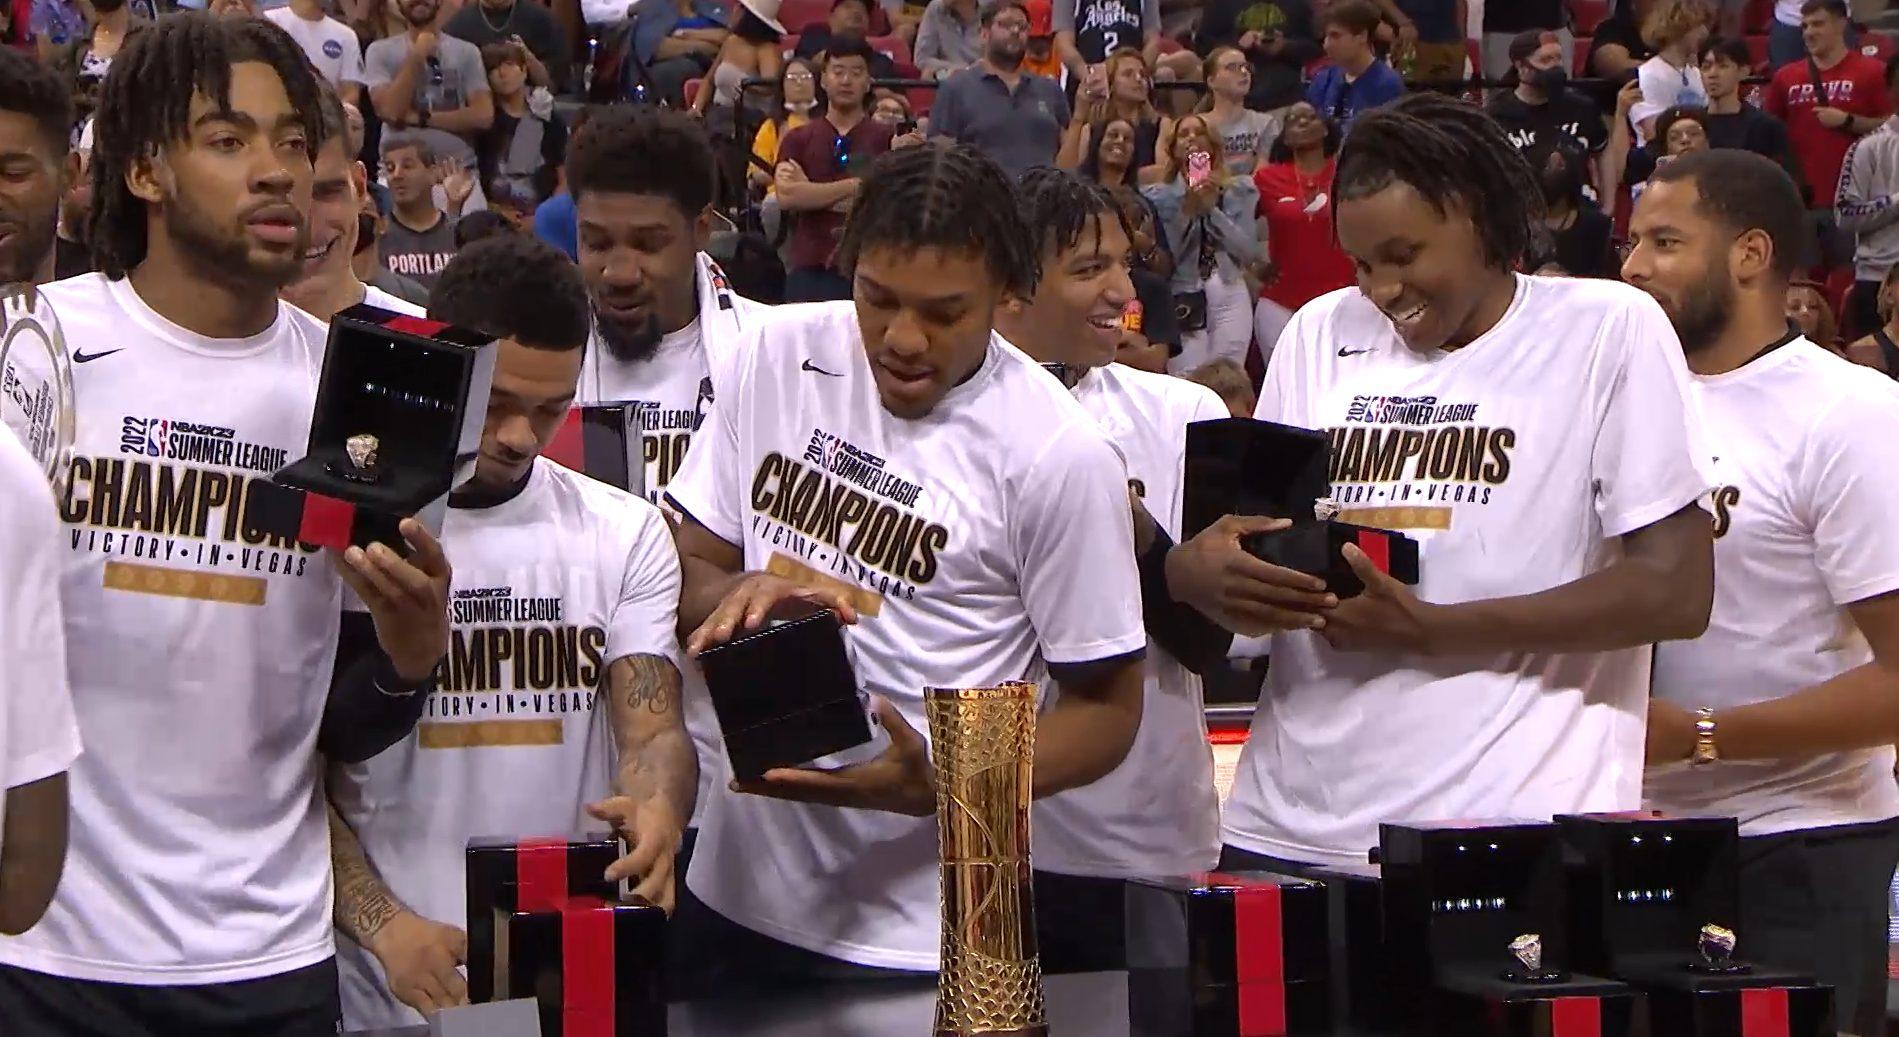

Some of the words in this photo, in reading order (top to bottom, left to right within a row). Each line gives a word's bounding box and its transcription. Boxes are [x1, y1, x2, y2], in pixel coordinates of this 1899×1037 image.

[1103, 31, 1118, 58] 2
[388, 252, 457, 275] PORTLA
[1380, 403, 1435, 425] SUMMER
[1432, 402, 1479, 424] LEAGUE
[120, 416, 149, 454] 2022
[170, 420, 236, 440] NBA2K23
[167, 432, 233, 468] SUMMER
[234, 440, 289, 473] LEAGUE
[803, 428, 828, 465] 2022
[1327, 427, 1516, 485] HAMPIONS
[829, 450, 883, 494] SUMMER
[876, 471, 925, 508] LEAGUE
[1335, 486, 1375, 504] TORY
[1391, 484, 1412, 501] IN
[1428, 484, 1492, 505] VEGAS
[751, 451, 949, 584] CHAMPIONS
[70, 528, 175, 561] VICTORY
[196, 544, 221, 567] IN
[241, 547, 307, 577] VEGAS
[454, 599, 513, 624] SUMMER
[513, 598, 562, 623] LEAGUE
[428, 696, 475, 718] TORY
[496, 694, 515, 714] IN
[533, 692, 593, 713] VEGAS
